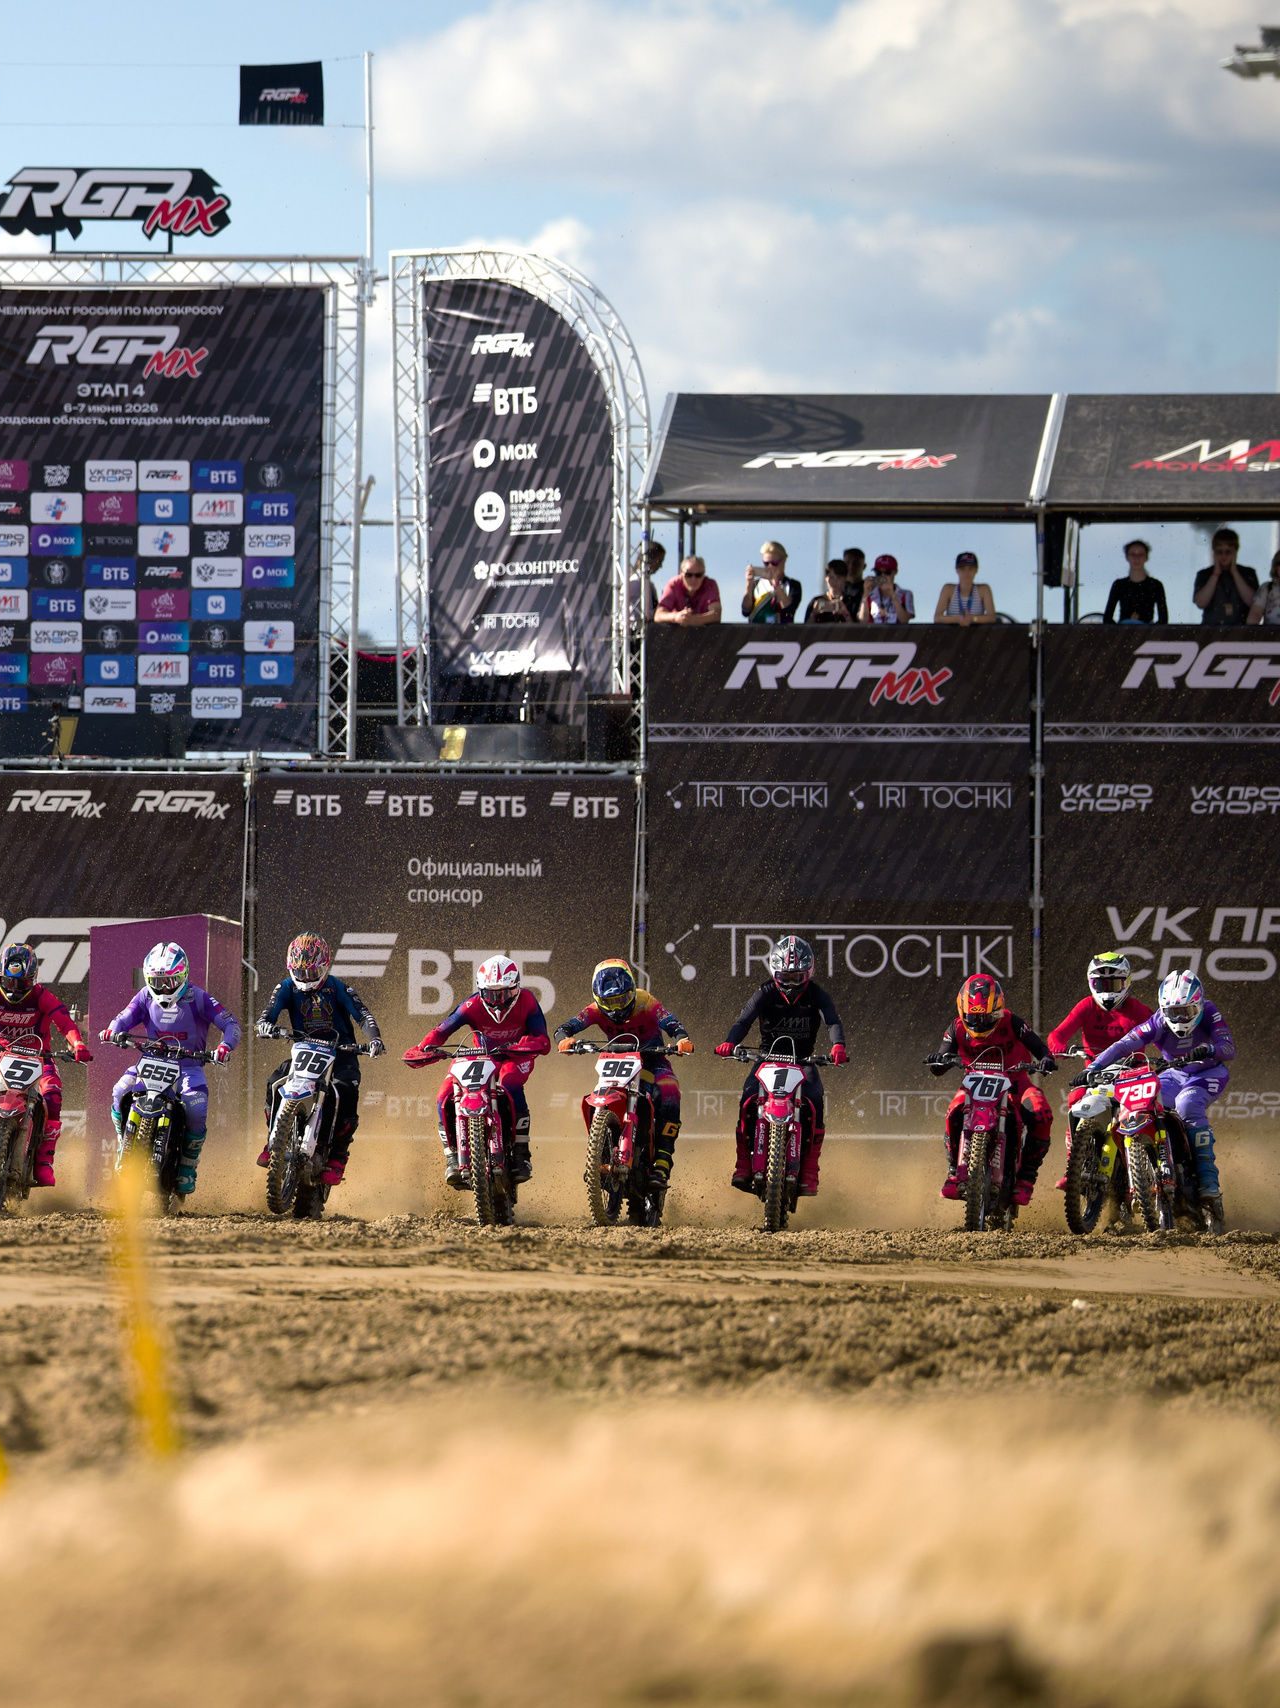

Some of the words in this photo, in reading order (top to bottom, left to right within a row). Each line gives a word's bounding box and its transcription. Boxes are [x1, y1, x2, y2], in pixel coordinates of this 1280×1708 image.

[259, 88, 301, 101] RGP
[0, 170, 193, 218] RGP
[144, 197, 227, 235] MX
[73, 305, 122, 316] РОССИИ
[124, 305, 141, 316] ПО
[143, 305, 224, 316] МОТОКРОССУ
[25, 325, 180, 364] RGP
[143, 348, 208, 379] MX
[471, 333, 525, 355] RGP
[511, 342, 534, 358] MX
[77, 384, 129, 397] ЭТАП
[131, 384, 145, 397] 4
[494, 387, 538, 415] ВТБ
[87, 404, 122, 414] июня
[124, 403, 159, 414] 2026
[52, 414, 108, 427] область,
[110, 415, 173, 426] автодром
[175, 414, 220, 427] «Игора
[222, 414, 271, 427] Драйв»
[742, 449, 926, 469] RGP
[878, 453, 957, 471] MX
[1130, 460, 1280, 472] MOTORSP
[210, 470, 236, 483] ВТБ
[263, 503, 288, 516] ВТБ
[102, 568, 129, 580] ВТБ
[482, 613, 496, 629] TRI
[502, 614, 539, 629] TOCHKI
[725, 641, 918, 689] RGP
[870, 667, 953, 705] MX
[689, 782, 723, 809] TRI
[736, 785, 827, 809] TOCHKI
[871, 782, 905, 809] TRI
[918, 786, 1011, 809] TOCHKI
[1061, 784, 1091, 797] VK
[1095, 784, 1153, 797] ПРО
[1191, 786, 1222, 799] VK
[9, 789, 91, 812] RGP
[72, 801, 106, 819] MX
[132, 790, 214, 812] RGP
[195, 802, 230, 820] MX
[296, 794, 342, 816] ВТБ
[388, 795, 434, 817] ВТБ
[480, 795, 527, 818] ВТБ
[573, 796, 620, 819] ВТБ
[1061, 797, 1153, 812] СПОРТ
[407, 858, 542, 879] Официальный
[407, 887, 483, 907] спонсор
[1107, 907, 1200, 941] VK
[815, 934, 1013, 978] TOCHKI
[484, 1027, 520, 1039] LEATT
[4, 1060, 39, 1081] 5
[294, 1051, 330, 1074] 95
[462, 1061, 485, 1083] 4
[602, 1061, 635, 1077] 96
[140, 1064, 178, 1083] 655
[773, 1069, 789, 1089] 1
[969, 1077, 1005, 1099] 761
[1119, 1082, 1156, 1104] 730
[386, 1096, 433, 1117] ВТБ
[872, 1091, 906, 1116] TRI
[1209, 1106, 1280, 1119] ПОРТ
